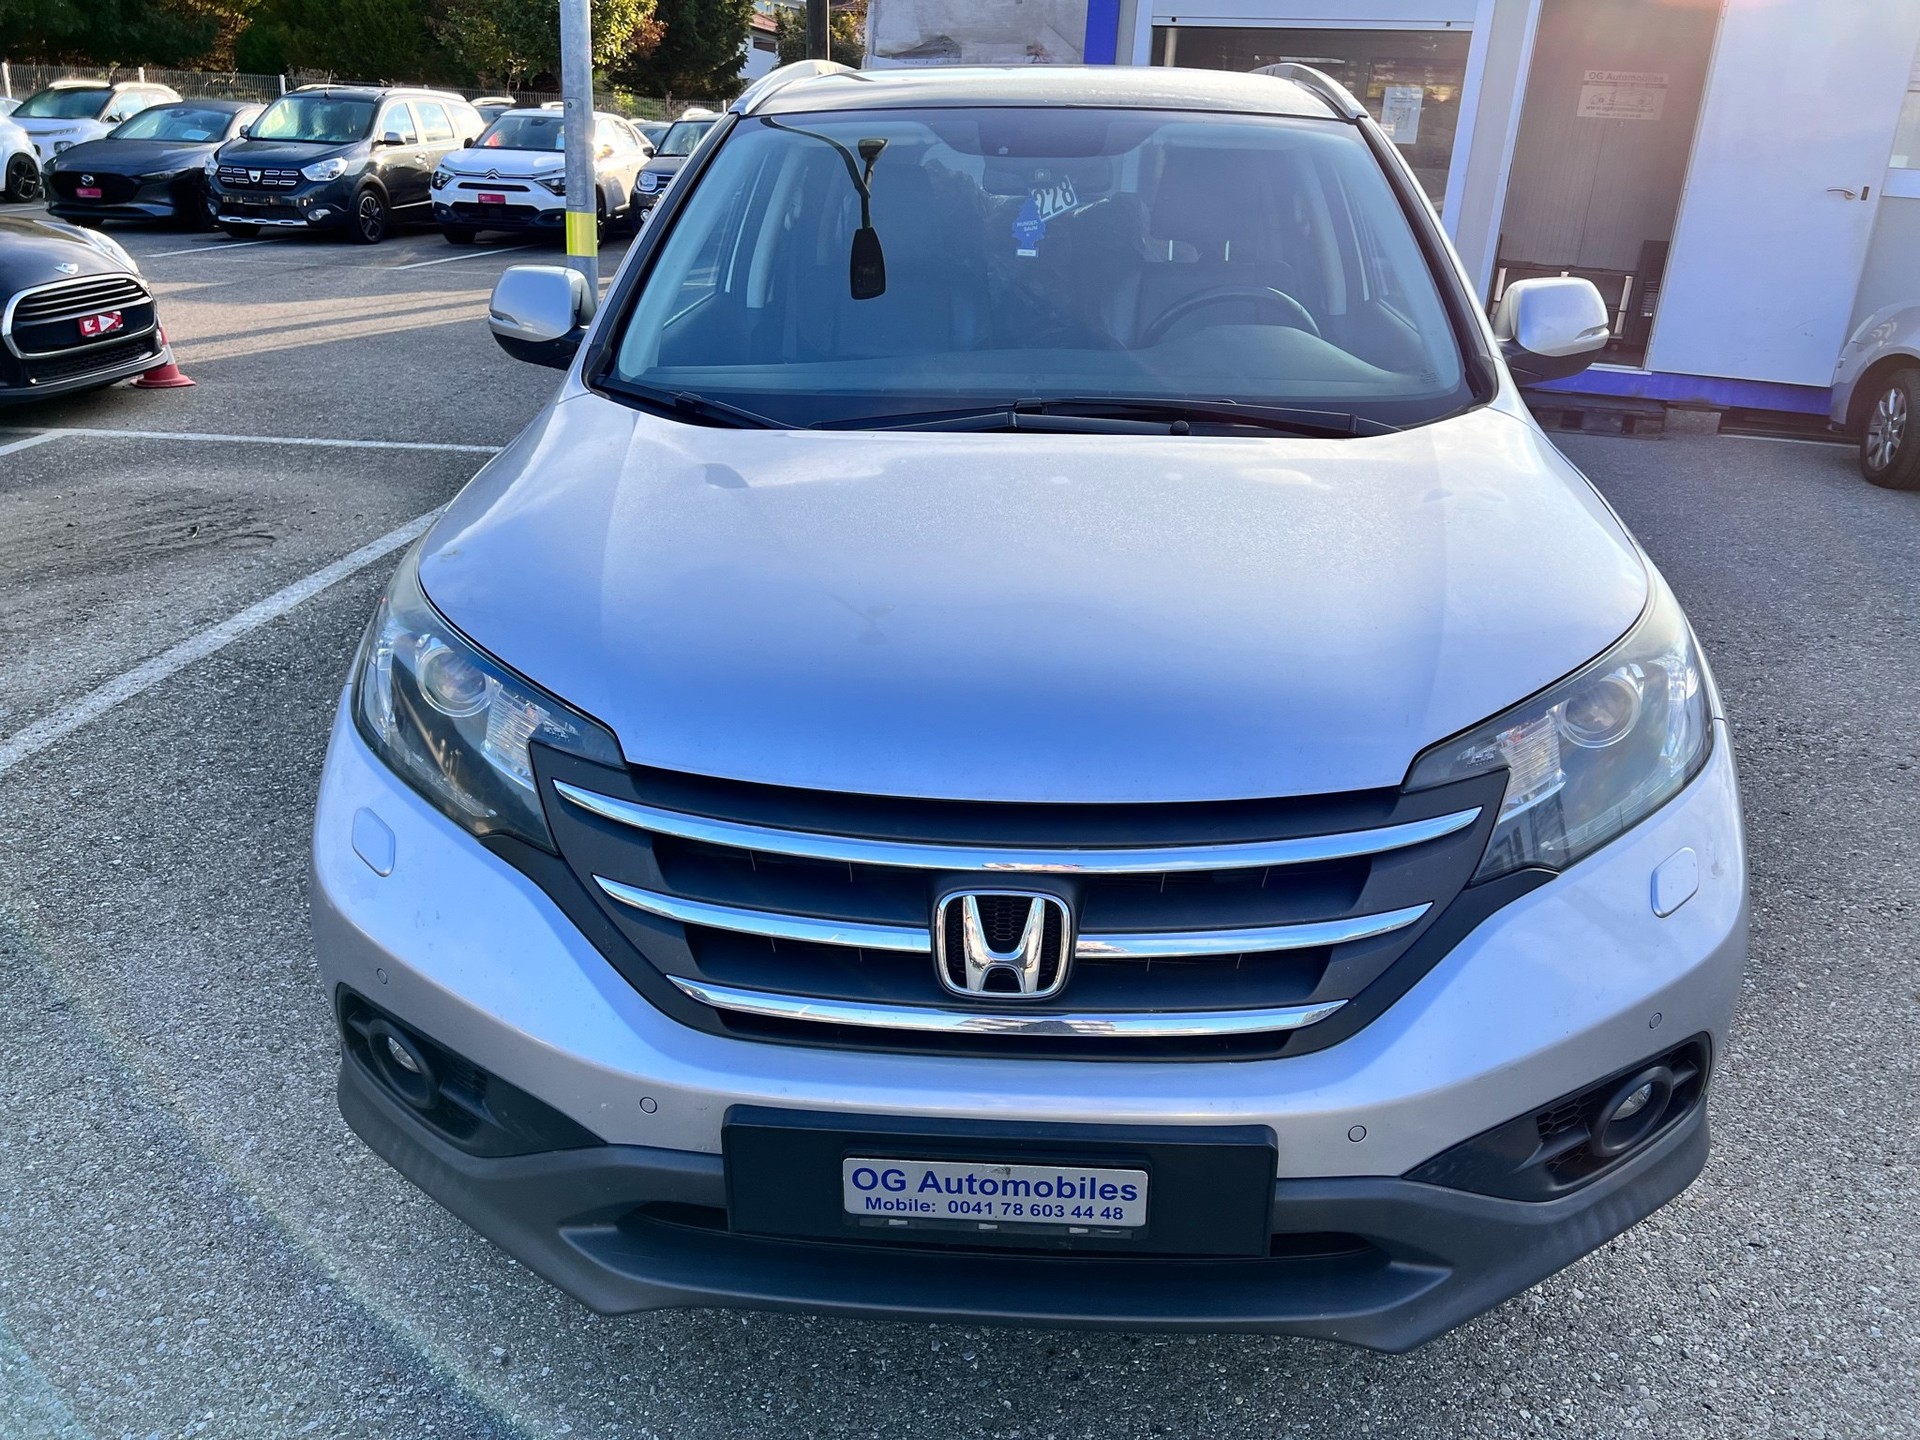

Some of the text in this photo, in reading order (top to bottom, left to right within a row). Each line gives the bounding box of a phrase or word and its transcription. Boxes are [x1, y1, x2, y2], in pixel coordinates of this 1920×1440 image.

[1588, 71, 1664, 83] OG Automobiles
[851, 1167, 1138, 1202] OG Automobiles
[864, 1196, 1124, 1220] Mobile: 0041 78 603 44 48
